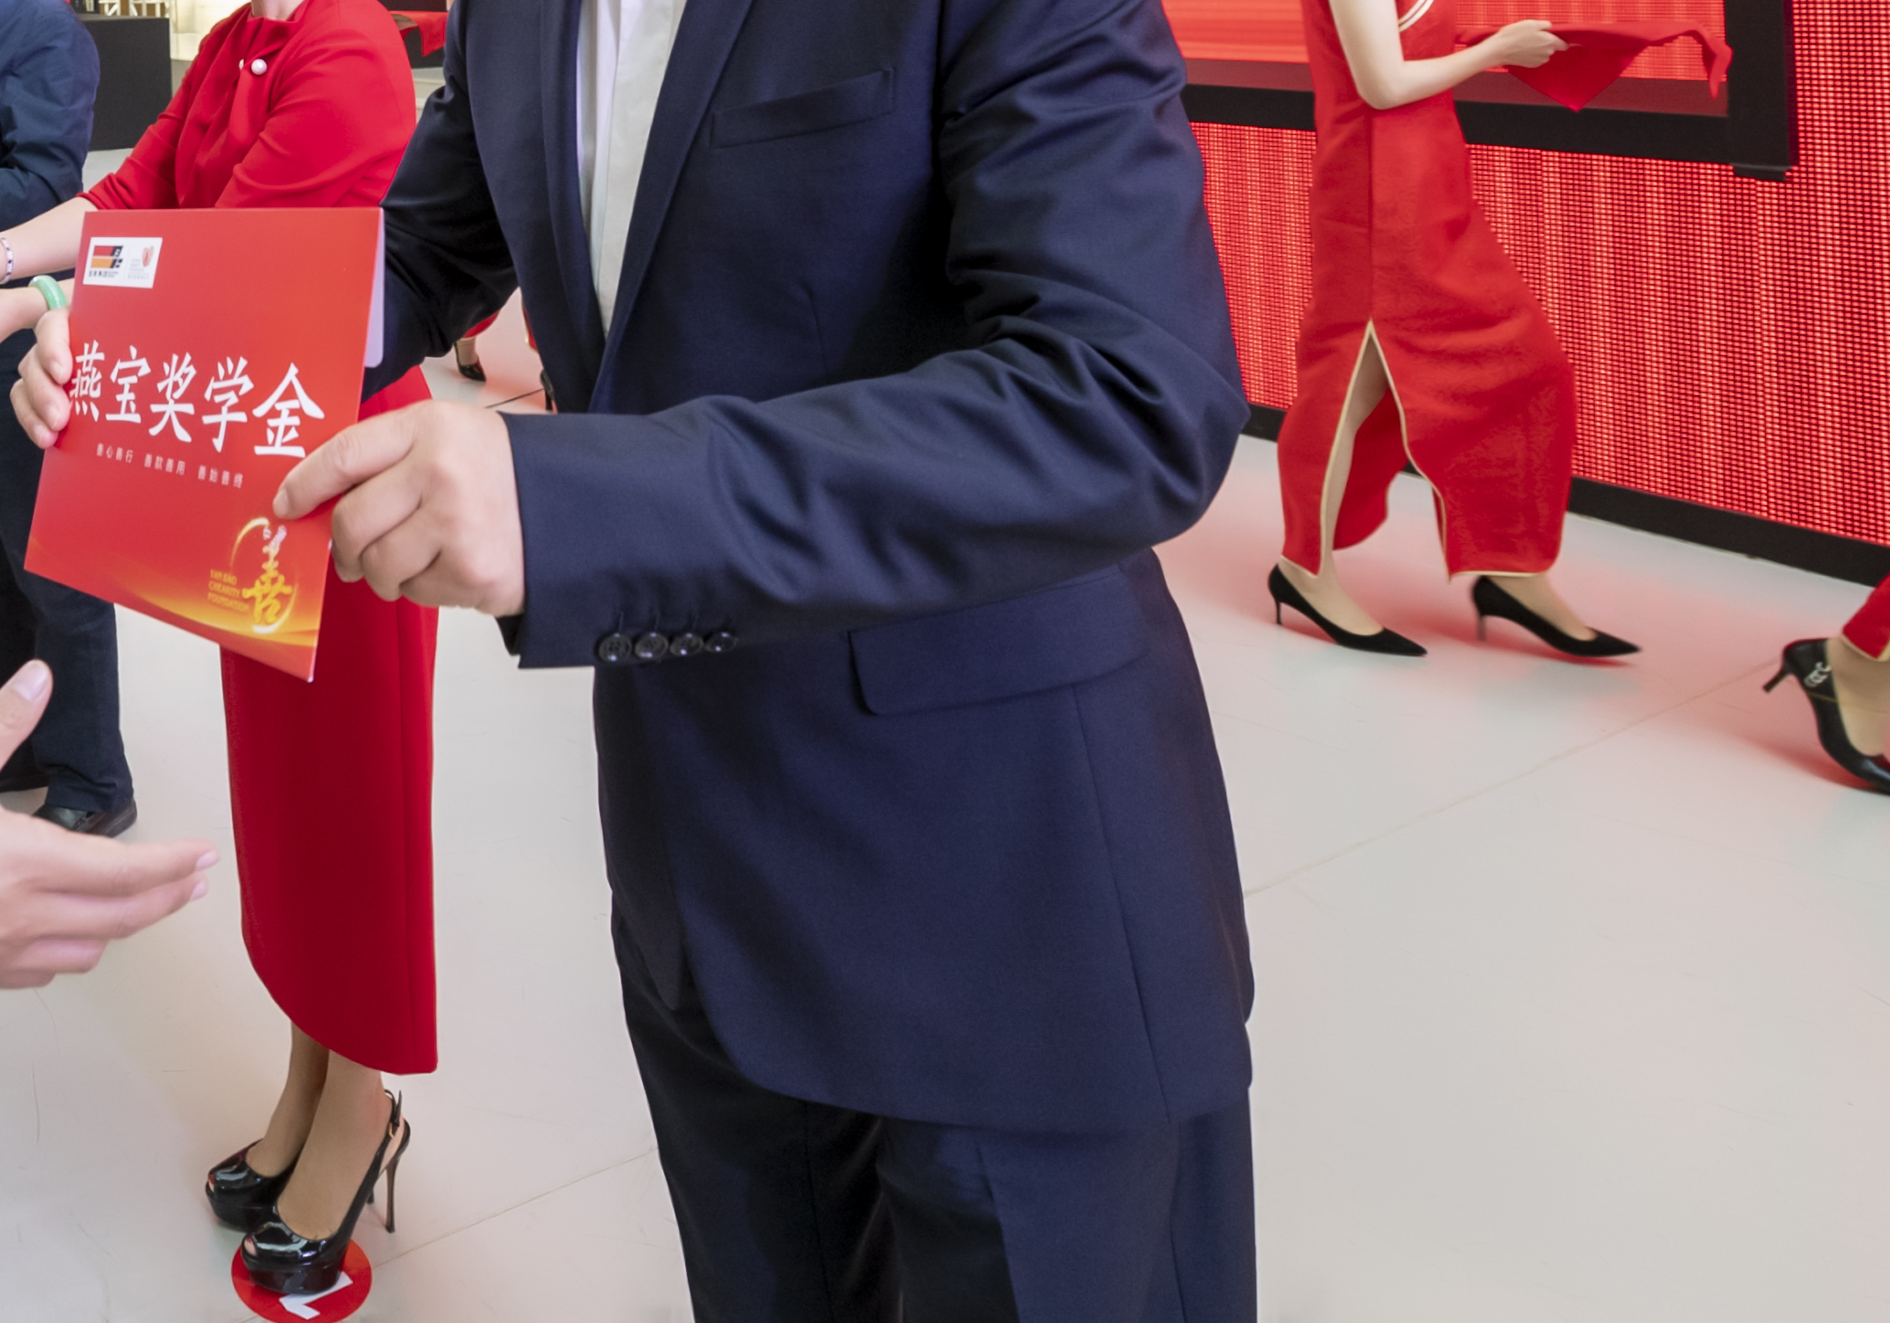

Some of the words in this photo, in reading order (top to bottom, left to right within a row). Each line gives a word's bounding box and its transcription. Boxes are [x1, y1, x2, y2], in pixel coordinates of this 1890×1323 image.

[69, 339, 325, 459] 燕宝奖学金
